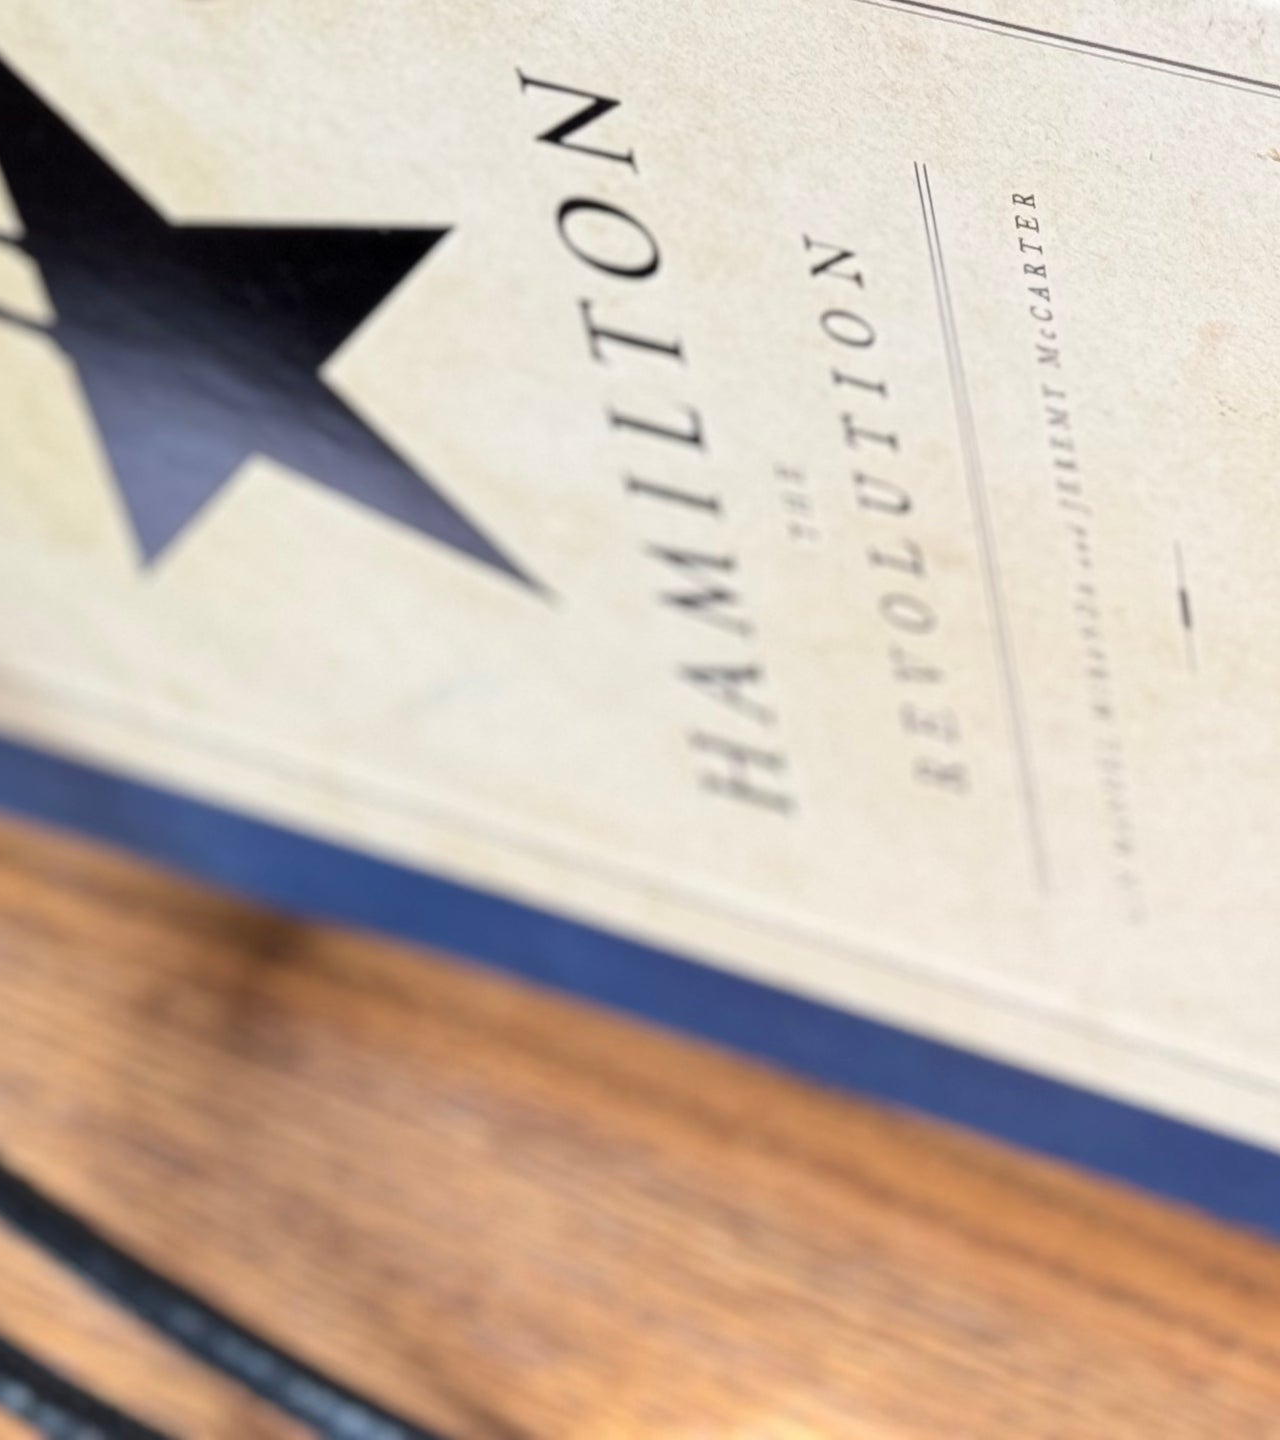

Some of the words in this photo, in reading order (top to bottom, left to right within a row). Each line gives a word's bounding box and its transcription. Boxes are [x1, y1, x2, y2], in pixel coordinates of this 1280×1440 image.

[515, 68, 797, 817] HAMILTON
[1012, 192, 1062, 369] McCARTER
[1042, 383, 1094, 516] JEREMY
[803, 232, 972, 796] REVOLUTION
